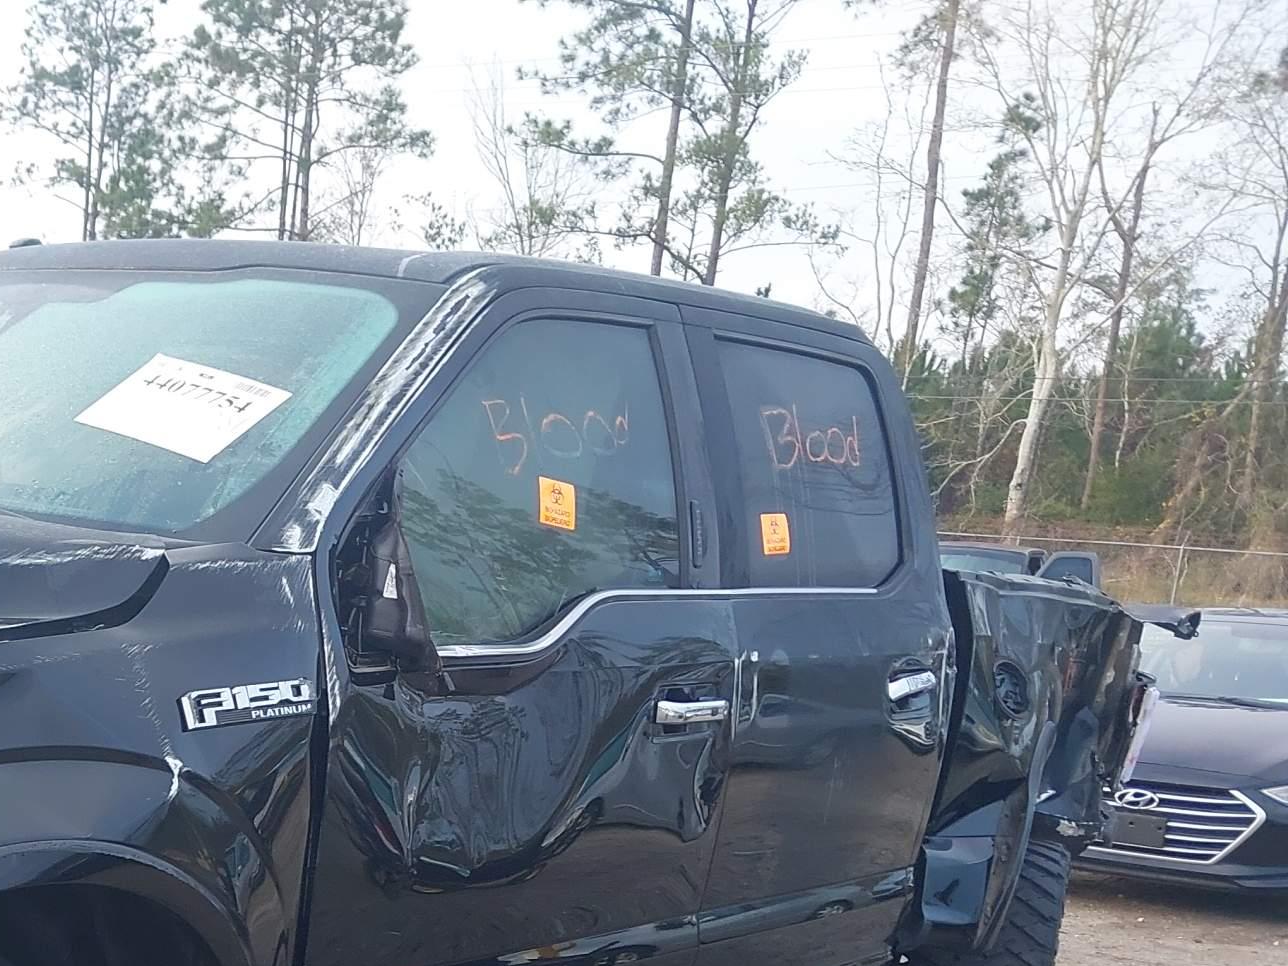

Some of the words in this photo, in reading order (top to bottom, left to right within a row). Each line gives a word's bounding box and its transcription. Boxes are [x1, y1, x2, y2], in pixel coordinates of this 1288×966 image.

[144, 375, 253, 413] 44077754
[480, 391, 629, 475] Blood
[759, 401, 860, 468] Blood
[251, 703, 313, 719] PLATINUM
